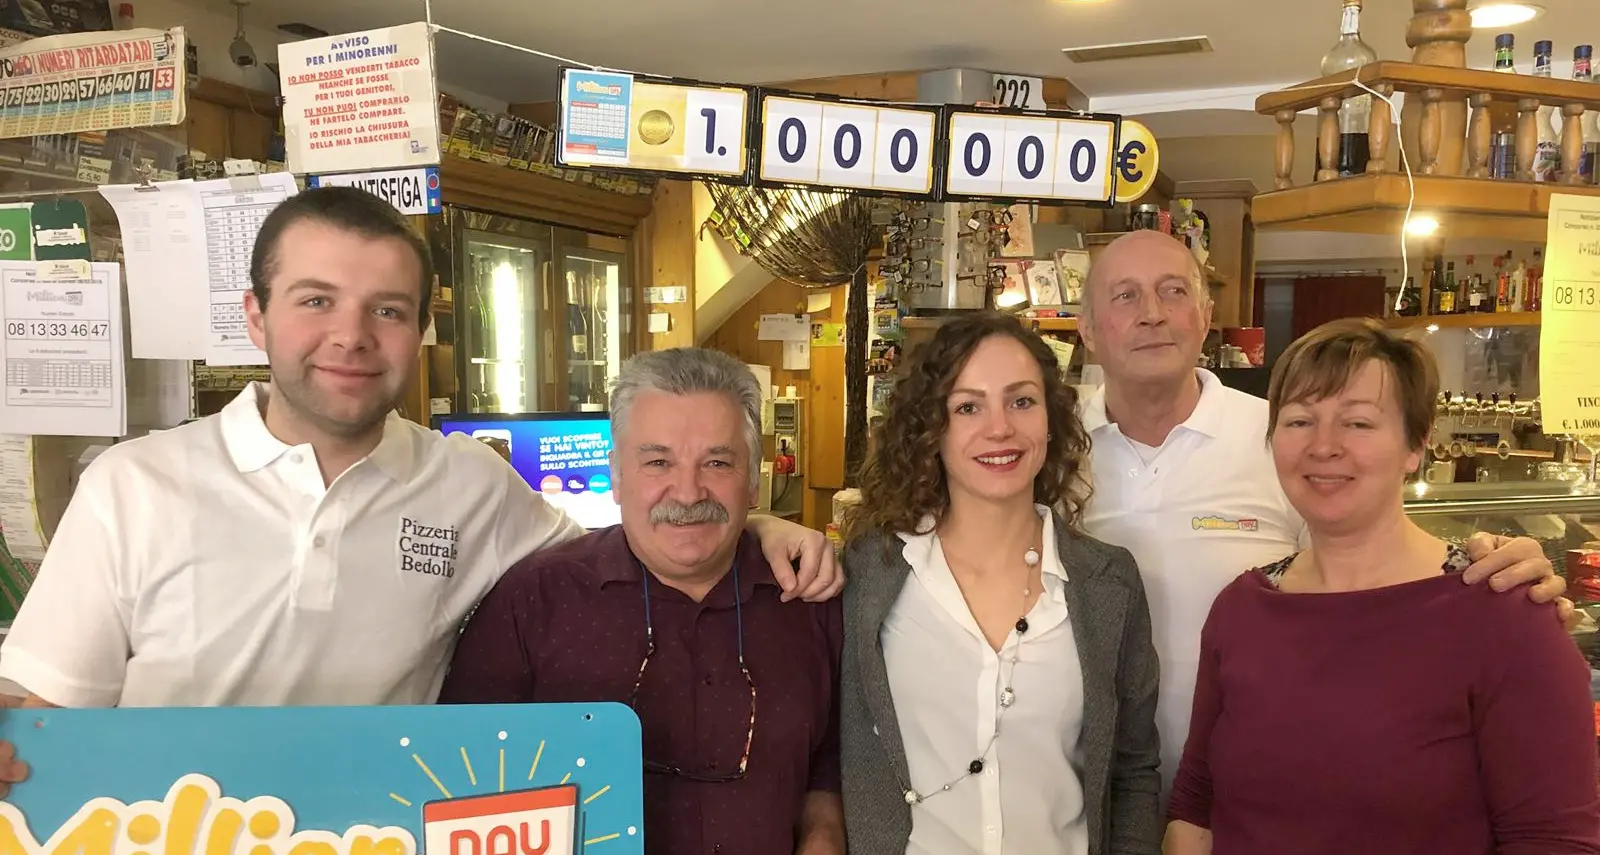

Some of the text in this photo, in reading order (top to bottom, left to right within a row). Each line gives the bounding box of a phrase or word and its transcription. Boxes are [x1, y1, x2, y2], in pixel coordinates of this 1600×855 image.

[38, 49, 75, 73] NUMERI
[76, 40, 152, 67] RITARDATARI
[306, 44, 398, 66] PER I MINORENNI
[288, 57, 420, 84] IO NON POSSO VENDERTI TABACCO
[8, 89, 23, 105] 75
[26, 86, 41, 103] 22
[43, 84, 59, 101] 30
[62, 81, 76, 100] 29
[80, 79, 95, 98] 57
[98, 77, 113, 95] 66
[115, 73, 132, 92] 40
[140, 71, 150, 89] 11
[156, 69, 173, 88] 53
[319, 79, 353, 89] NEANCHE
[366, 74, 389, 84] FOSSE
[315, 92, 329, 101] PER
[336, 89, 353, 99] TUOI
[304, 96, 410, 117] TU NON PUOI COMPRARLO
[323, 114, 356, 124] FARTELO
[309, 131, 318, 139] IO
[321, 127, 352, 138] RISCHIO
[368, 120, 409, 132] CHIUSURA
[310, 140, 333, 150] DELLA
[336, 138, 351, 146] MIA
[1118, 140, 1145, 183] €
[1555, 286, 1595, 305] 08 13
[8, 322, 108, 336] 08 13 33 46 47
[540, 435, 560, 444] VUOI
[540, 444, 551, 453] SE
[554, 443, 572, 452] HAI
[540, 458, 610, 471] SULLO SCONTRIN
[399, 536, 457, 560] Centrale
